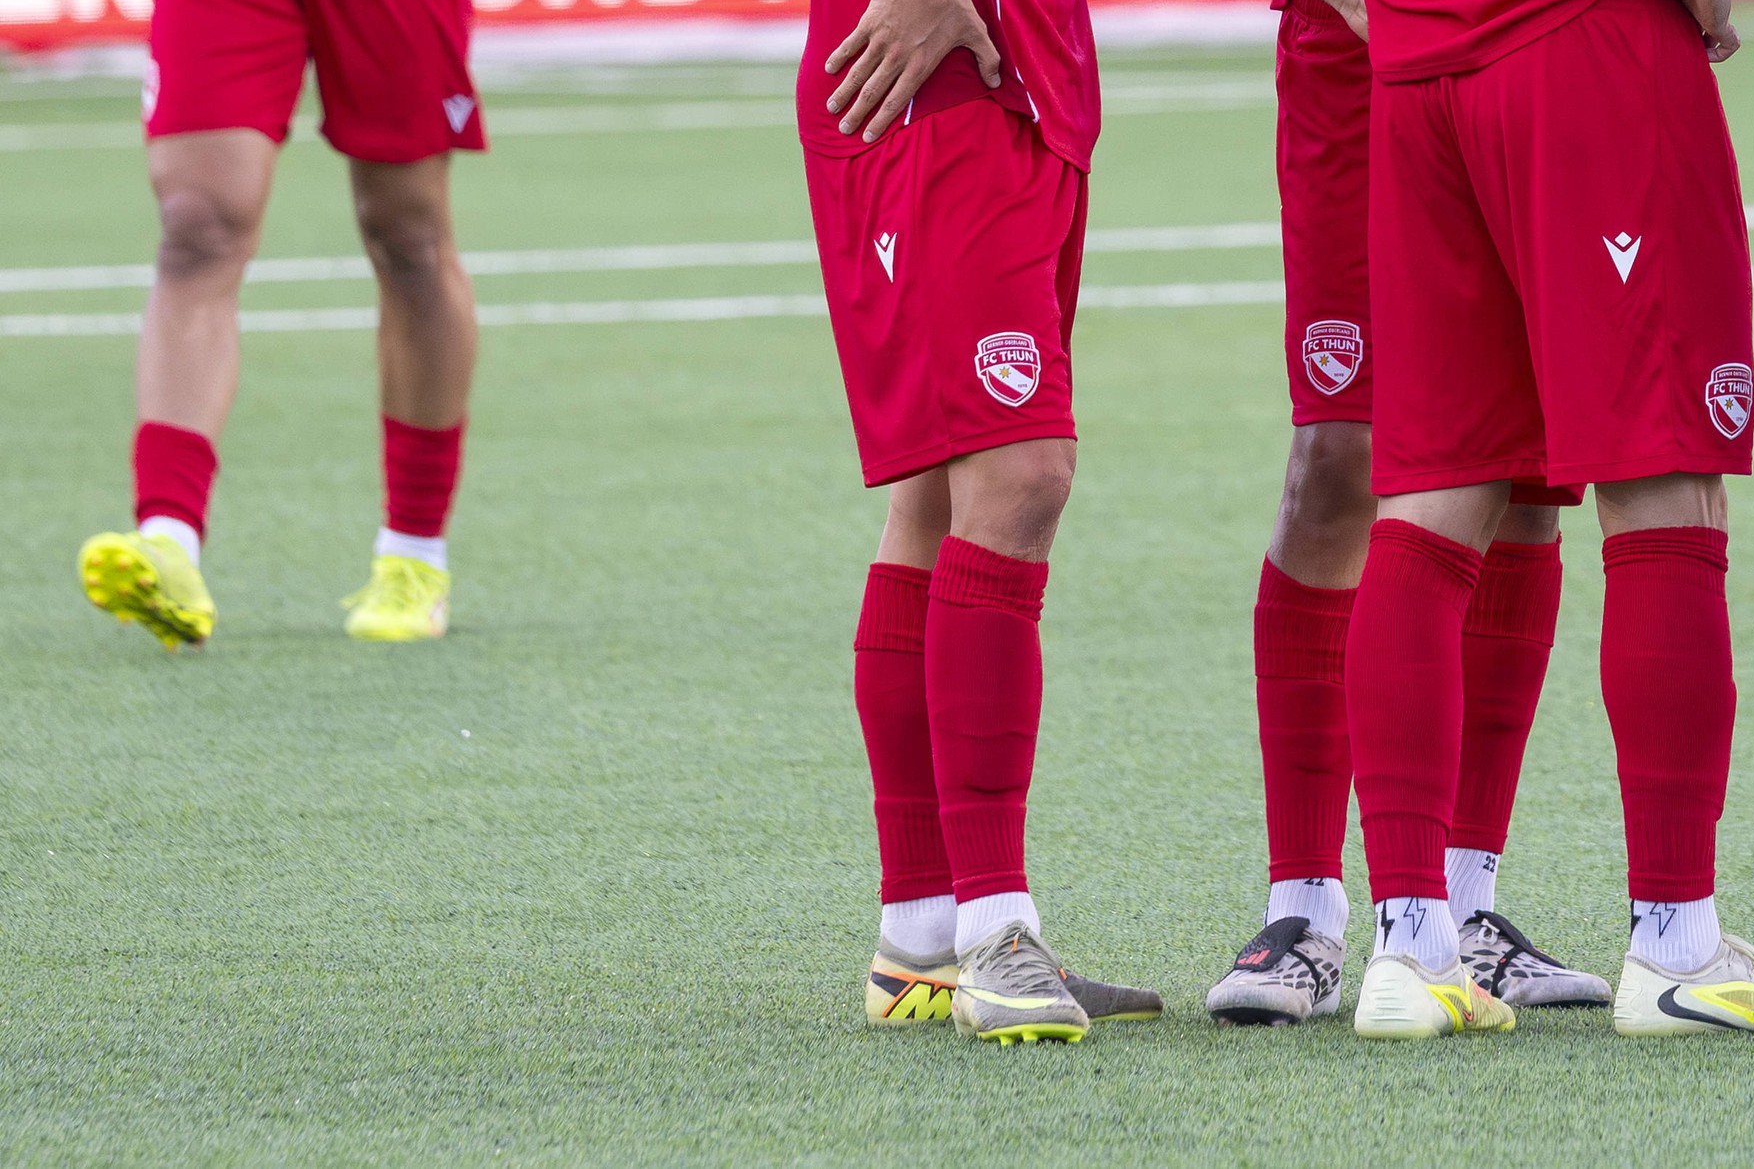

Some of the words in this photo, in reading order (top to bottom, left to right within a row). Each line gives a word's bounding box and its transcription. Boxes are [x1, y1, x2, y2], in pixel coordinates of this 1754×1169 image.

[1308, 339, 1320, 352] FC
[1322, 338, 1355, 352] THUN
[983, 353, 997, 366] FC
[999, 350, 1034, 362] THUN
[1713, 382, 1726, 395] FC
[1728, 382, 1750, 395] THUN
[1482, 854, 1497, 873] 22
